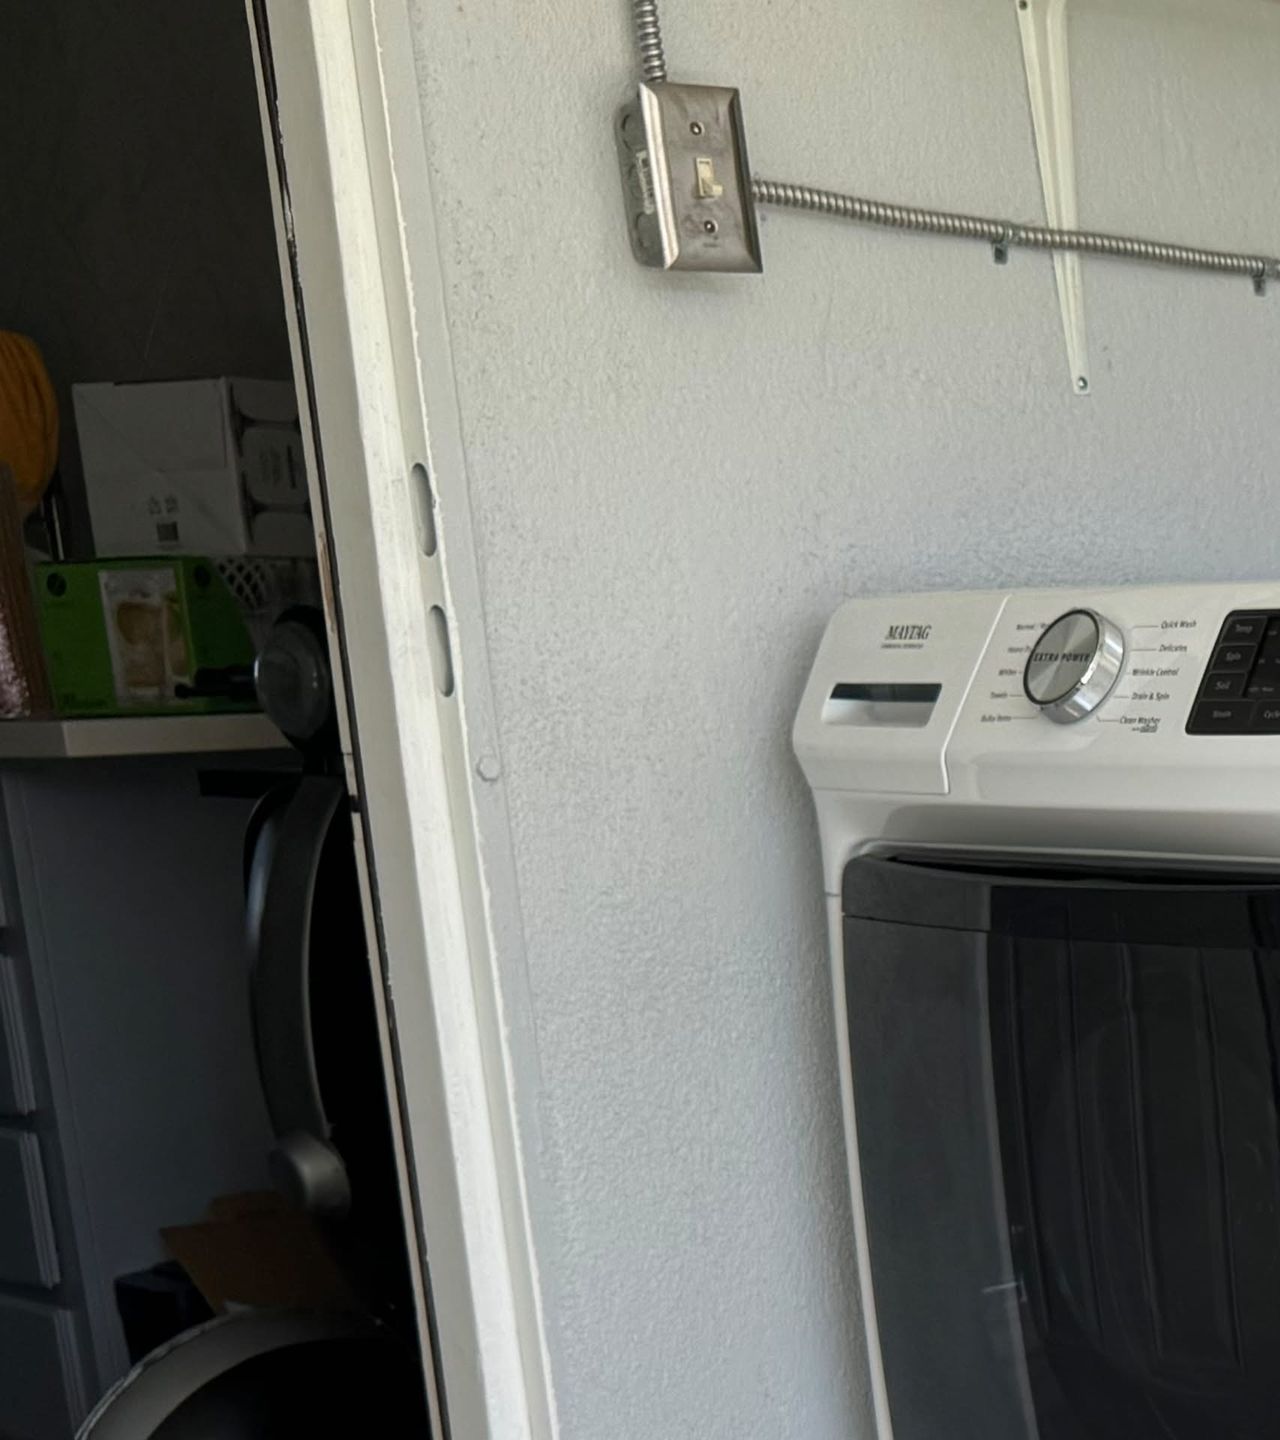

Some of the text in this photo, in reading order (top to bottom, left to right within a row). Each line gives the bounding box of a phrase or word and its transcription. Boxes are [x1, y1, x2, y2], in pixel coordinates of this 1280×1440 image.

[1160, 620, 1197, 630] Quick Wash
[885, 625, 932, 640] MAYTAG
[1033, 653, 1091, 662] EXTRA POWER
[1156, 668, 1179, 676] Control
[1155, 693, 1170, 702] Spin
[1119, 717, 1137, 725] Clean
